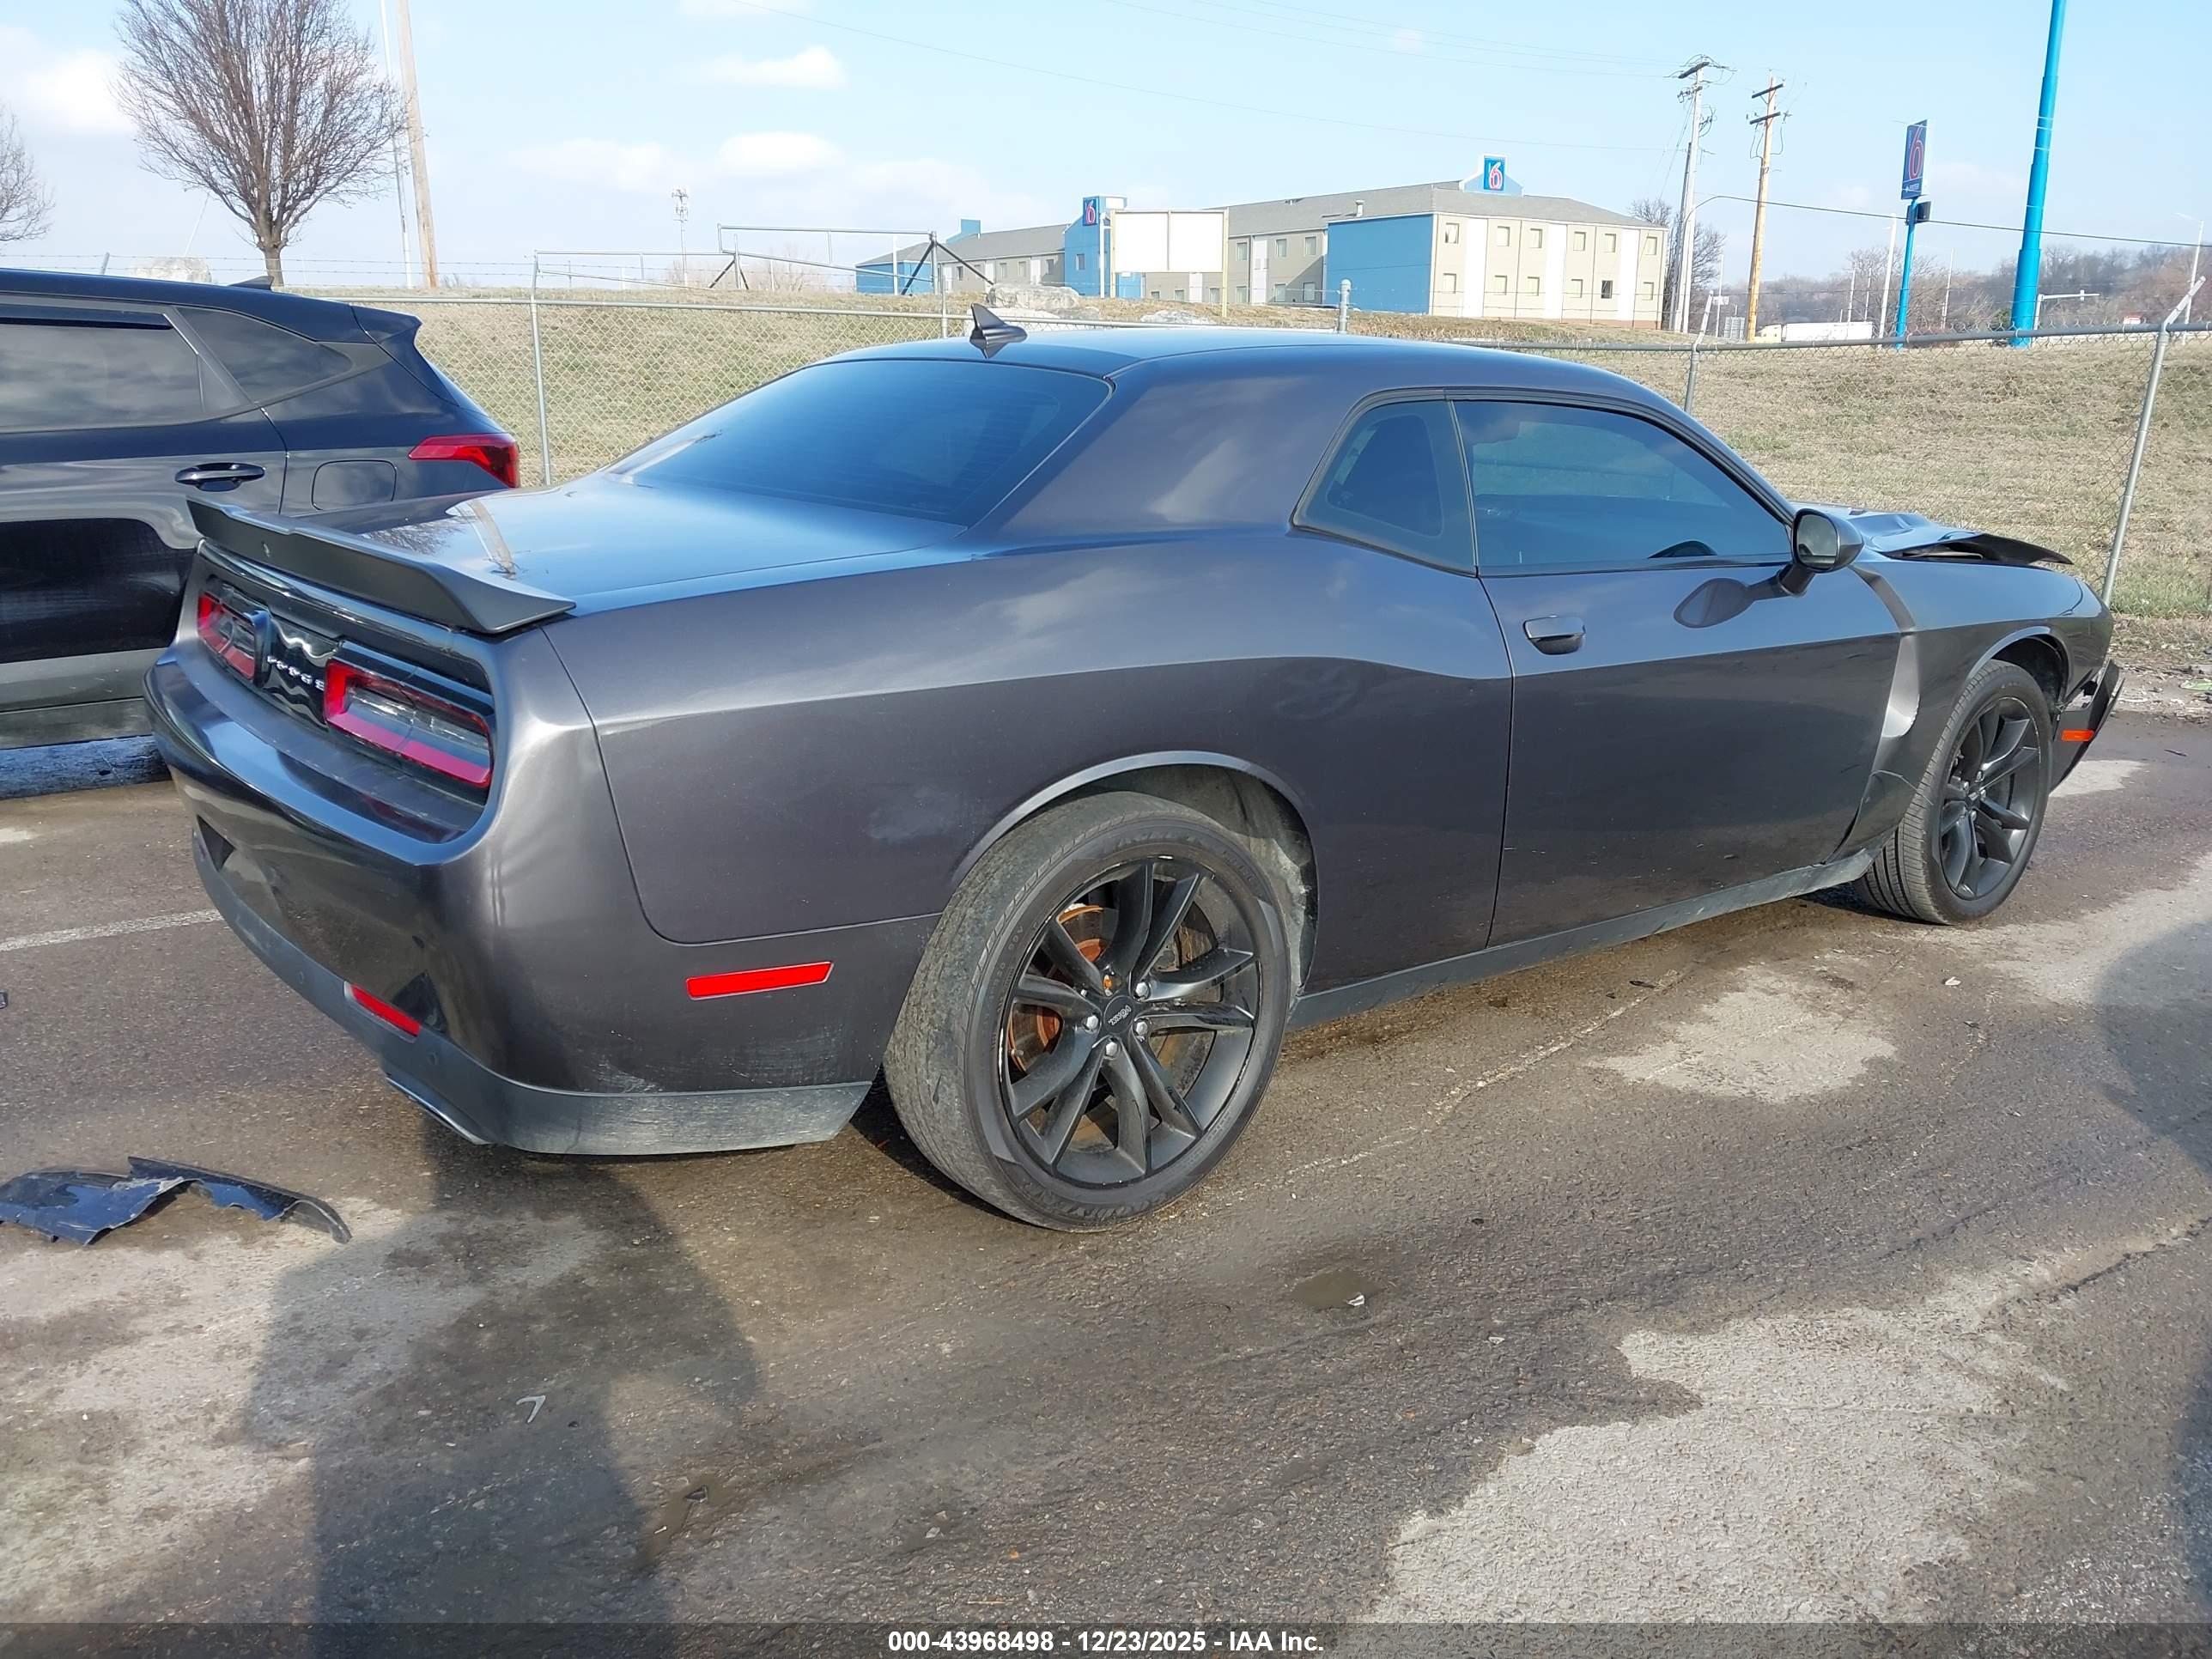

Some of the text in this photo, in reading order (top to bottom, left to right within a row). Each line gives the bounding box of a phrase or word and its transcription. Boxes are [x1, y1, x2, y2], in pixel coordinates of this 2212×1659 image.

[1909, 123, 1924, 179] 6
[1489, 161, 1503, 190] 6
[1085, 198, 1096, 224] 6
